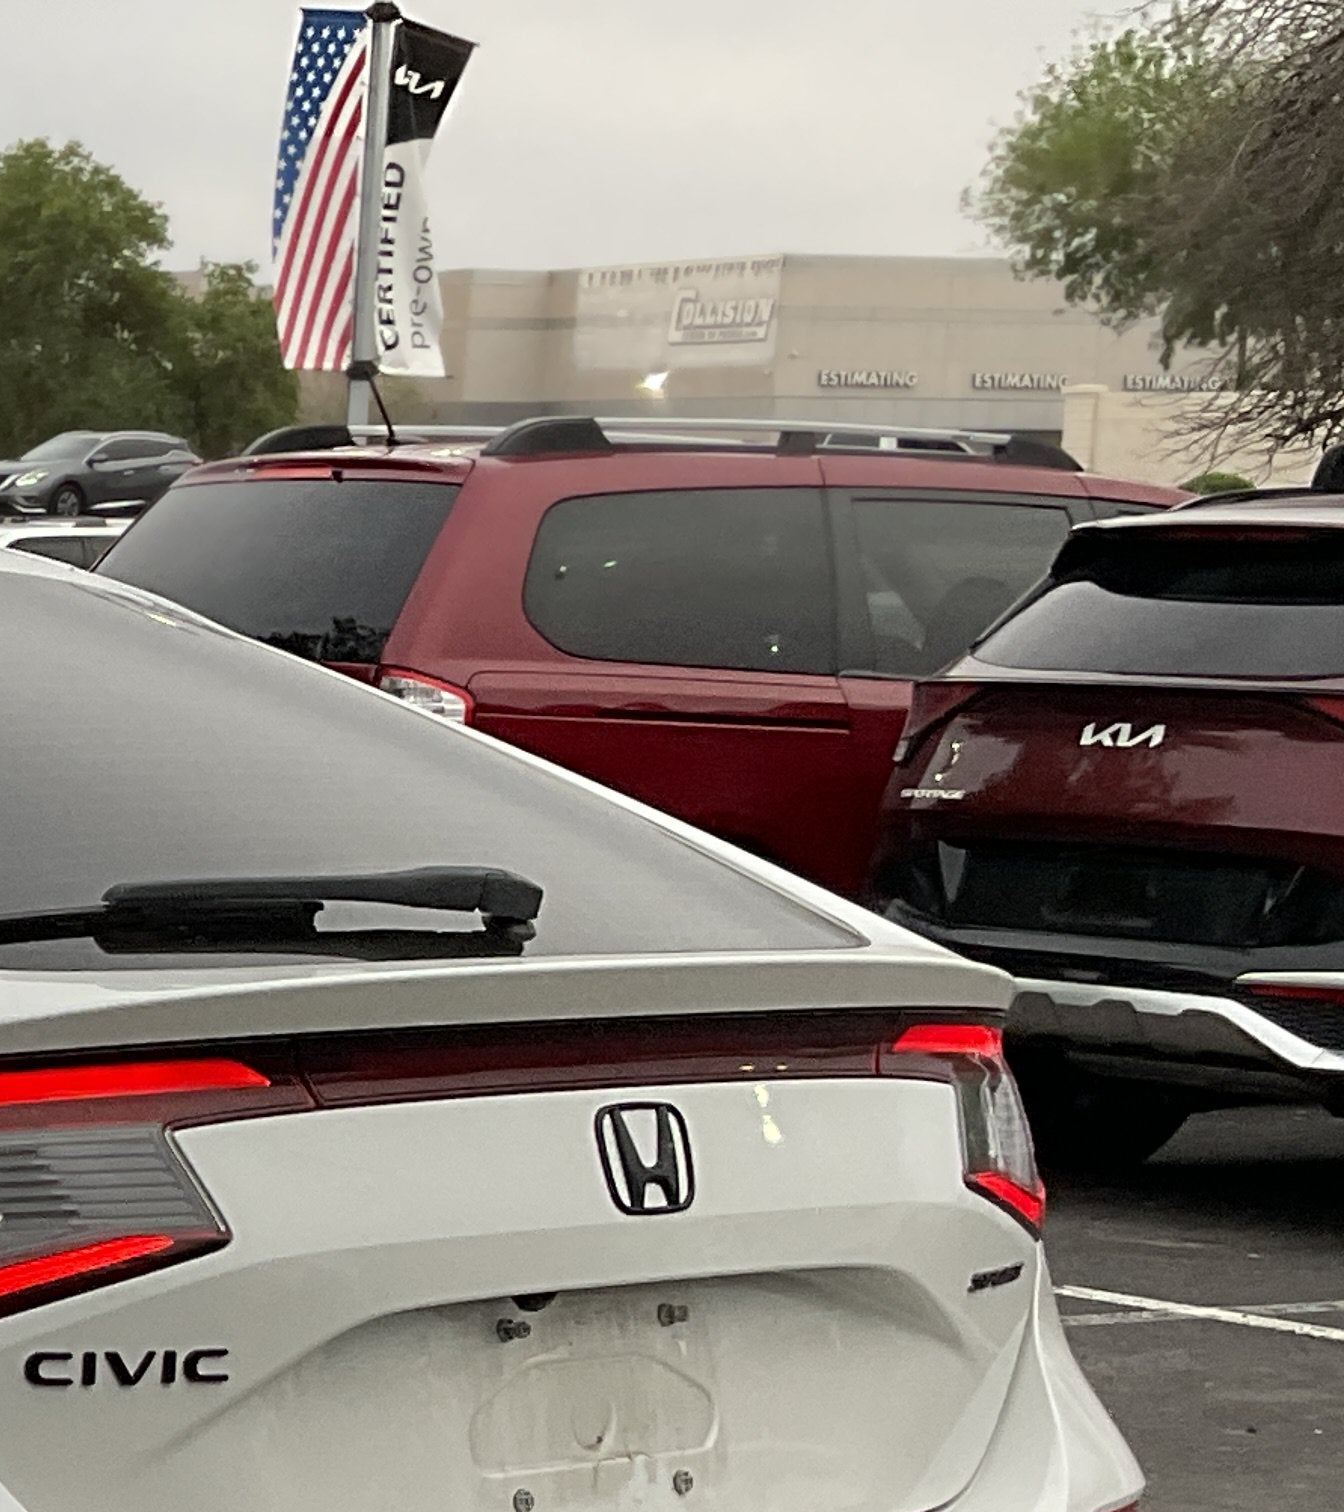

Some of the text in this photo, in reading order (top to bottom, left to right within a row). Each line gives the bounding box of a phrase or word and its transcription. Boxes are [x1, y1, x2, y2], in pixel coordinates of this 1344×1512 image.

[377, 162, 406, 352] CERTIFIED
[668, 287, 775, 340] COLLISION
[817, 369, 919, 388] ESTIMATING
[1079, 722, 1166, 748] KIA
[23, 1348, 229, 1386] CIVIC
